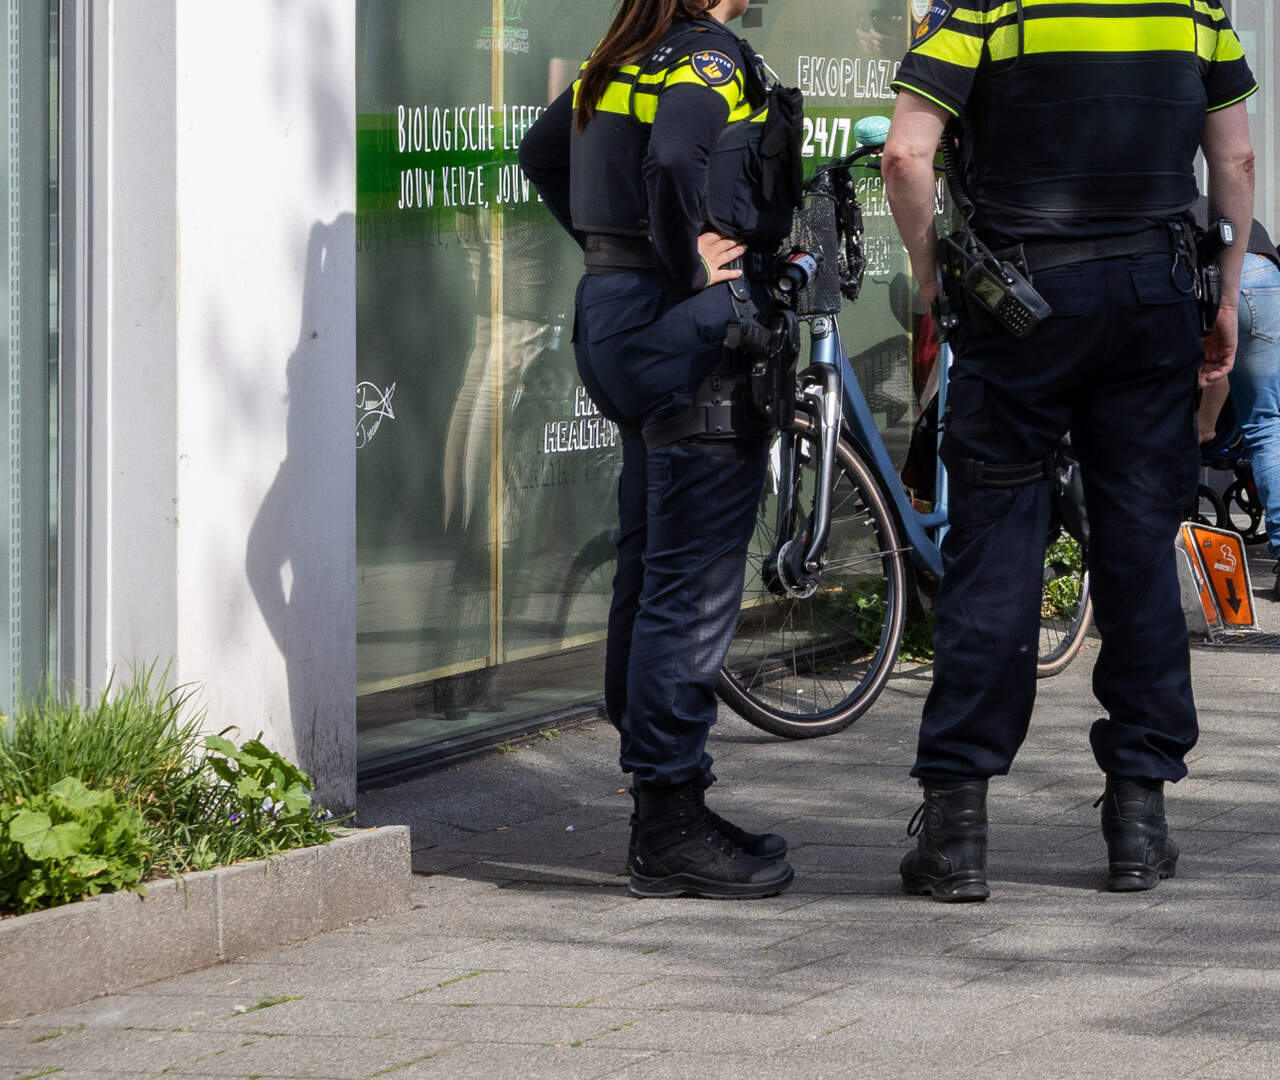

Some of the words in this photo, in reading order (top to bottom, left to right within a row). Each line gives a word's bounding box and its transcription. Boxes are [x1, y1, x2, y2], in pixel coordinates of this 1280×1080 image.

[398, 103, 495, 153] BIOLOGISCHE
[801, 117, 852, 157] 24/7
[398, 167, 434, 210] JOUW
[442, 166, 490, 209] KEUZE,
[496, 164, 531, 204] JOUW
[543, 416, 617, 455] HEALTHY
